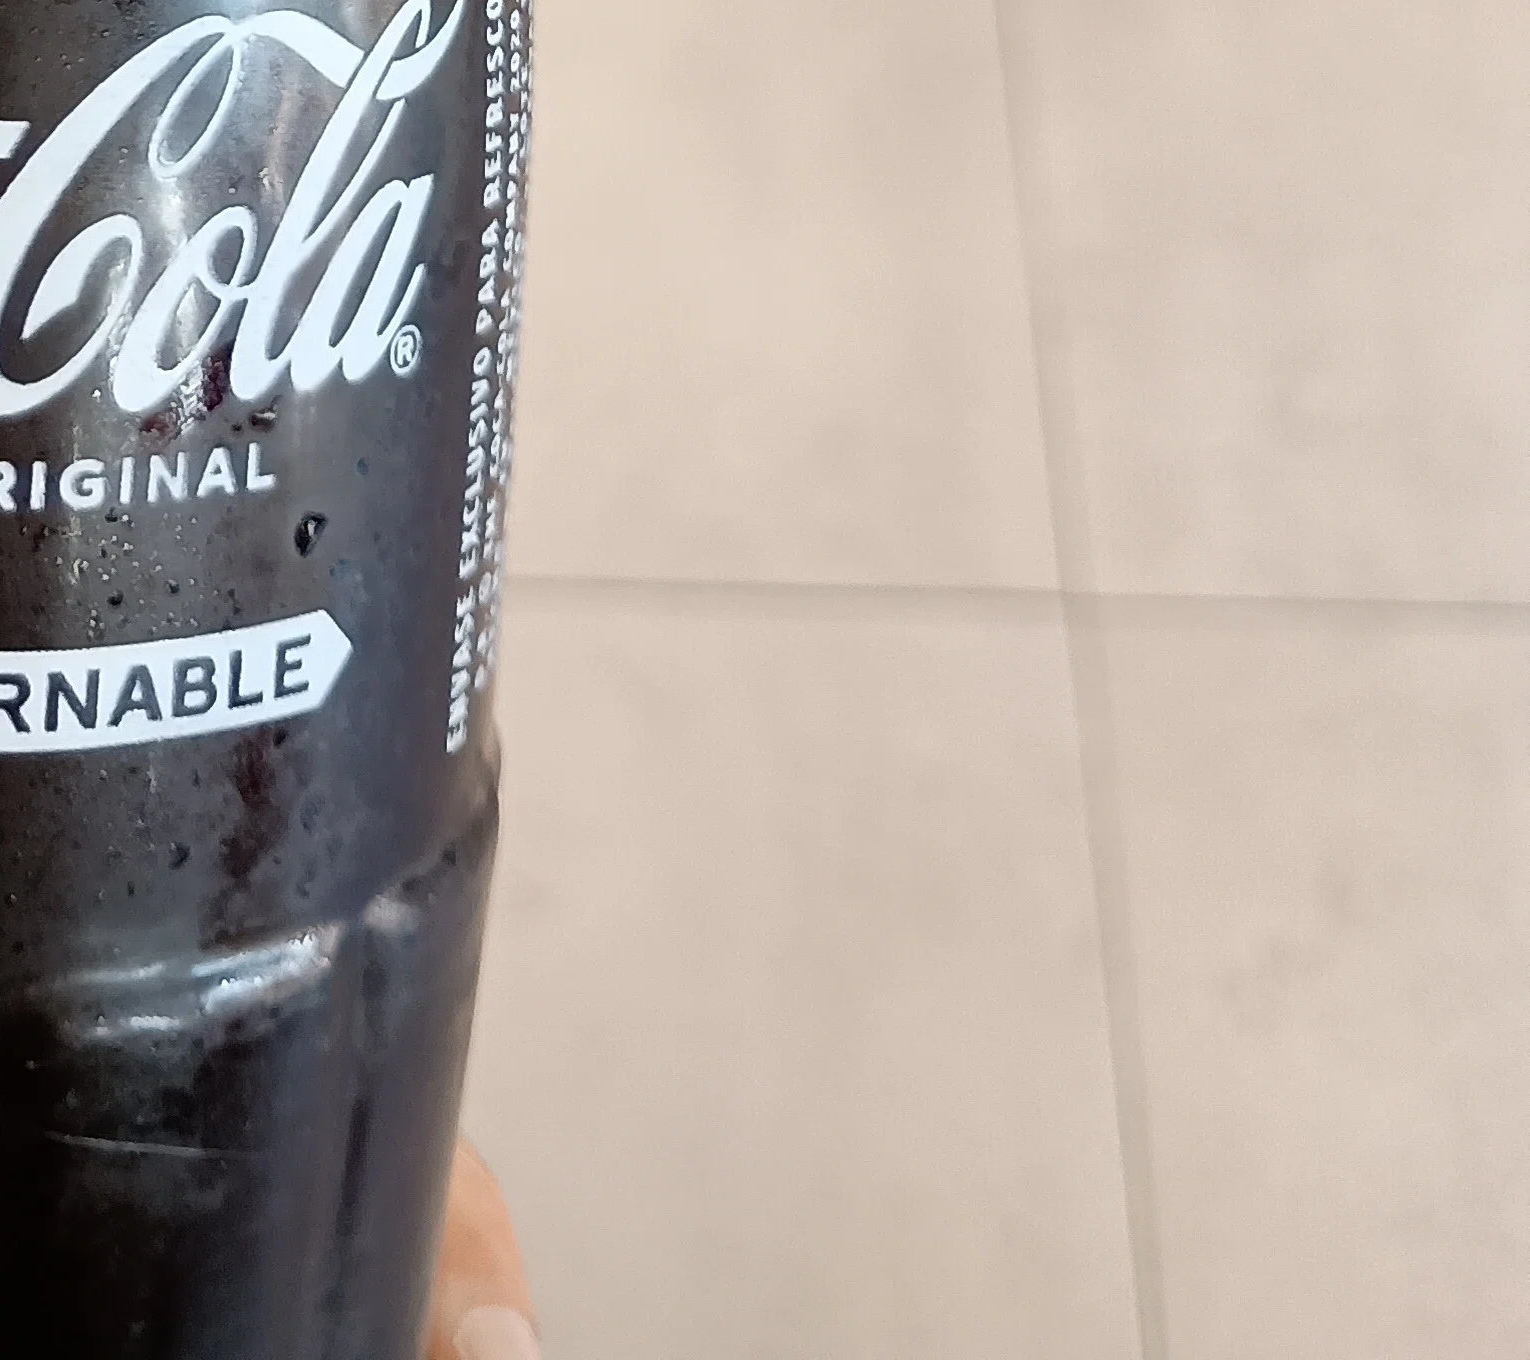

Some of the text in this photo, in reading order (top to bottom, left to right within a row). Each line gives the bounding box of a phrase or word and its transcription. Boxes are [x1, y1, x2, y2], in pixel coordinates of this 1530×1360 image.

[475, 217, 500, 338] PARA
[458, 345, 494, 580] EXCLUSIVO
[446, 584, 476, 755] ENVASE
